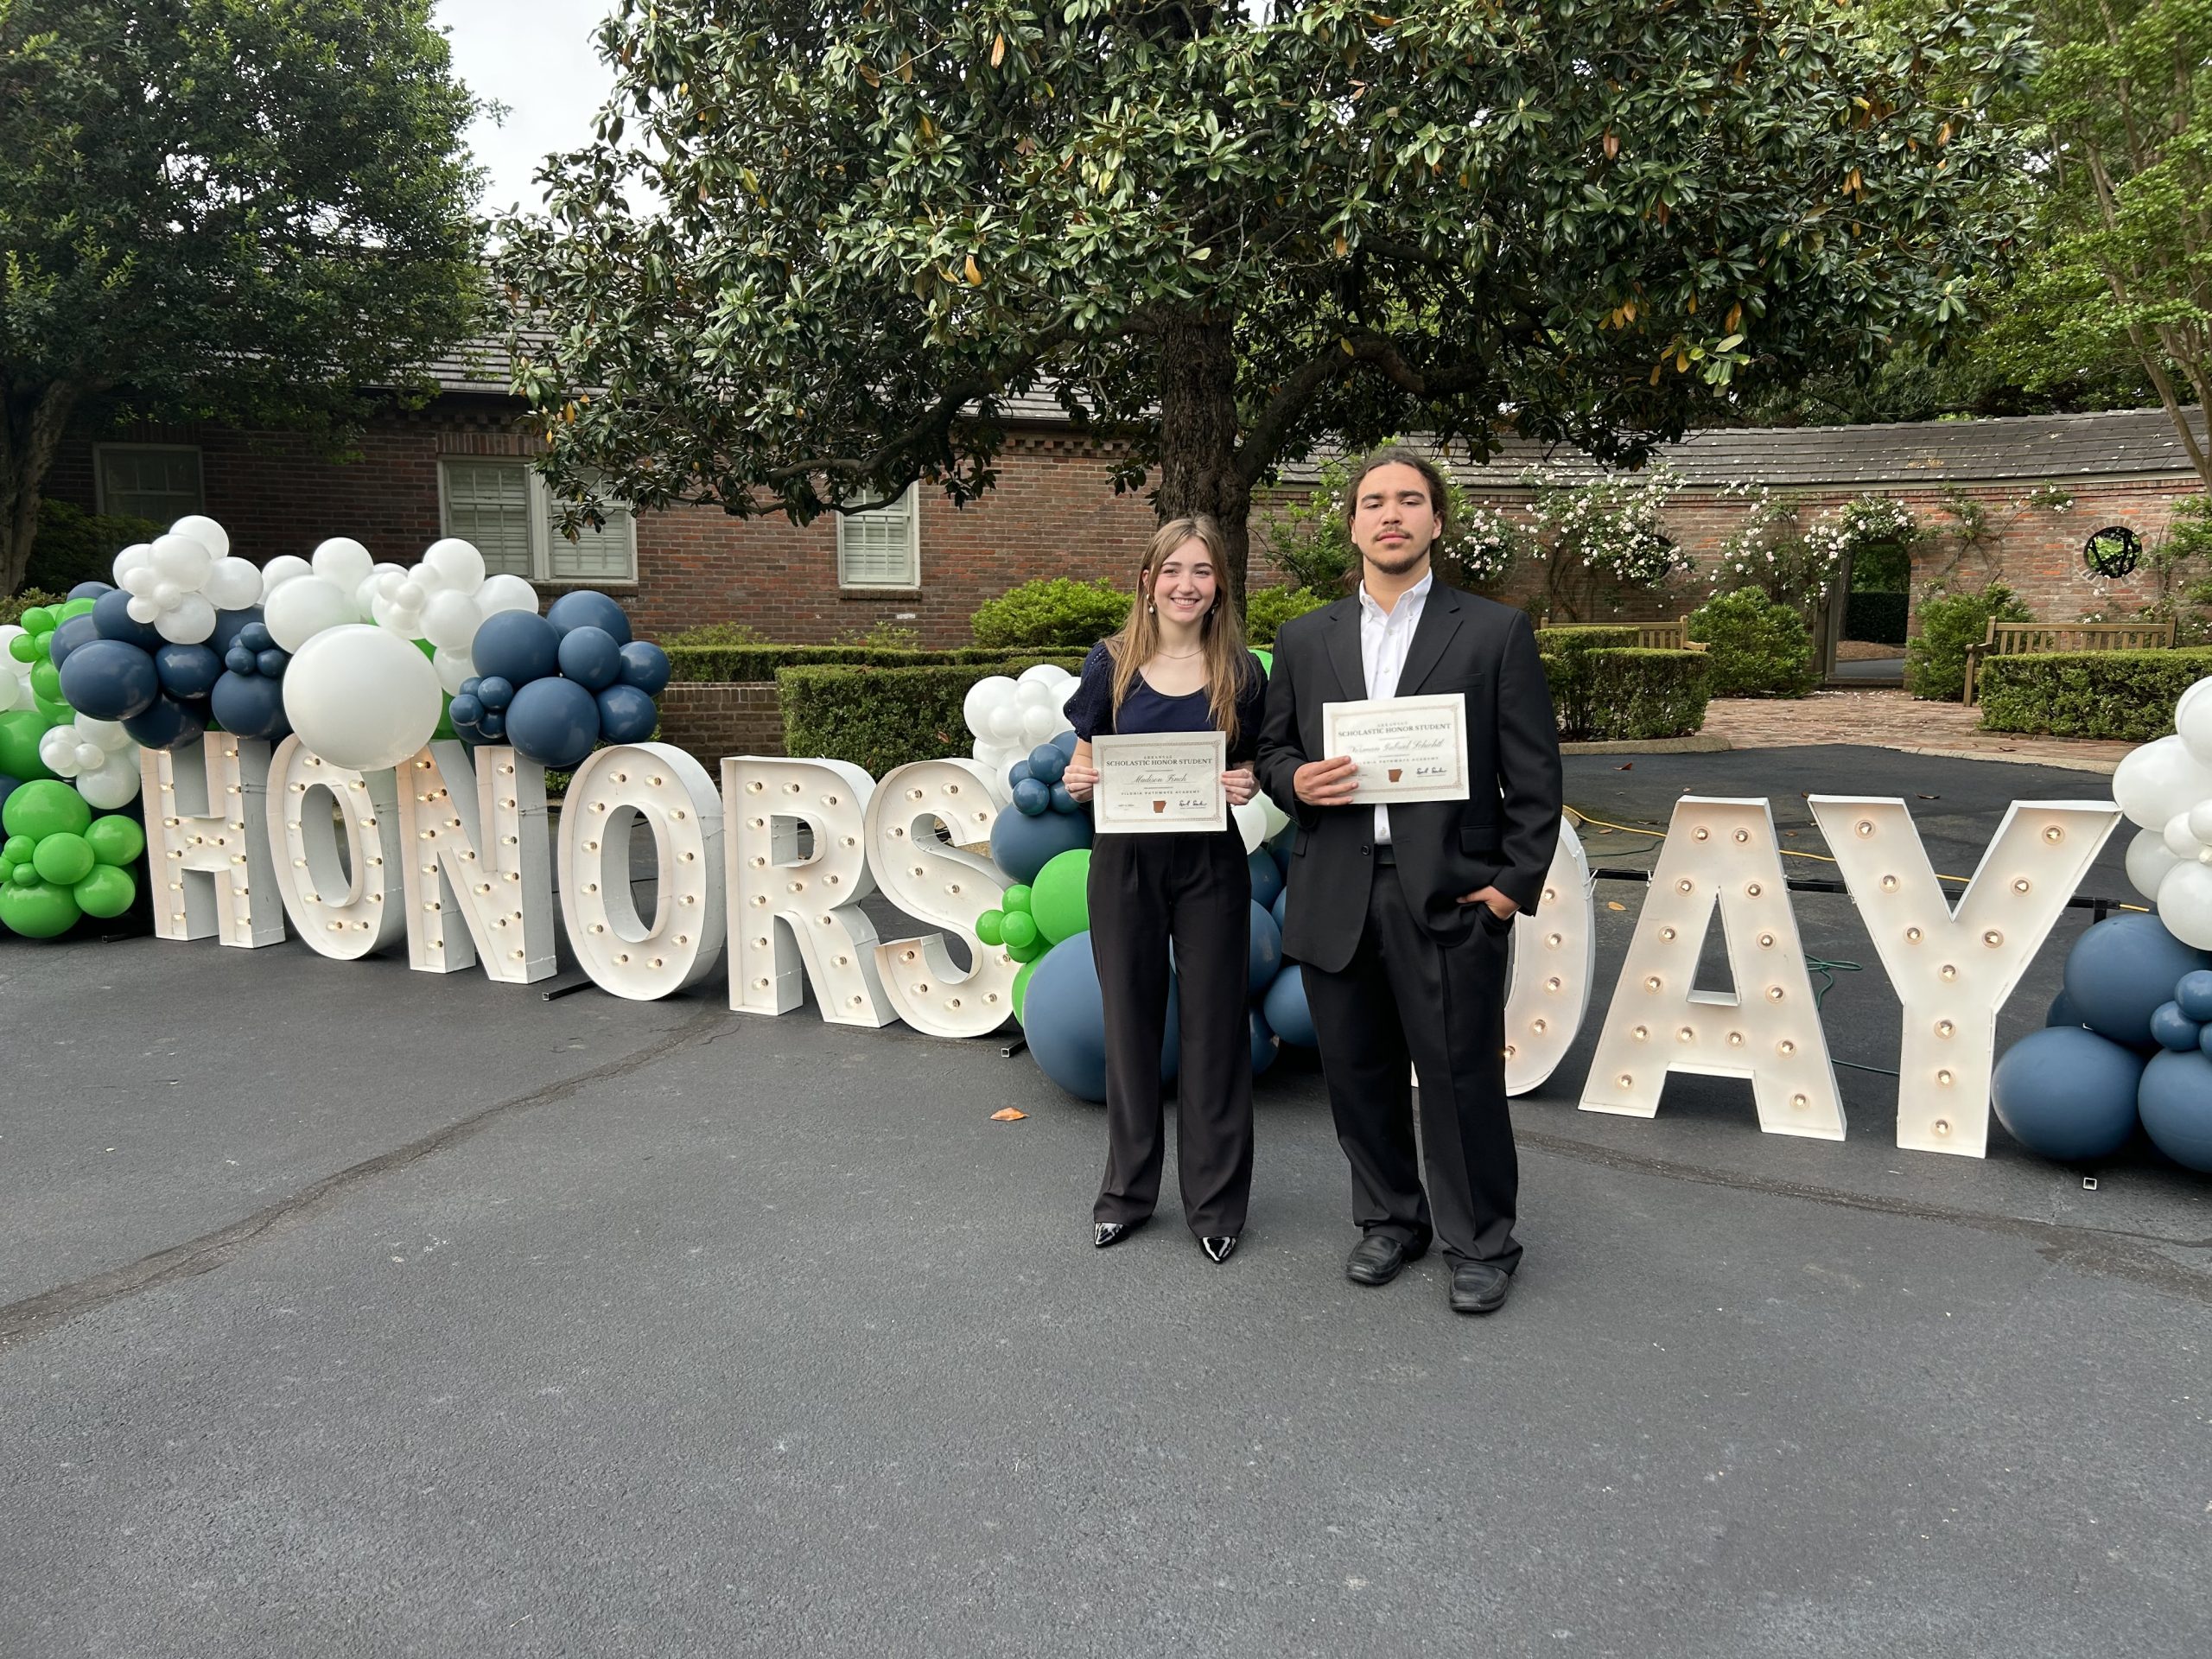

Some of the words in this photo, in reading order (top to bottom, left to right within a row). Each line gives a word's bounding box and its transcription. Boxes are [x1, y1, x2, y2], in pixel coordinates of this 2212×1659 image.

[1338, 728, 1383, 737] SCHOLASTIC
[1385, 725, 1414, 734] HONOR
[1414, 723, 1452, 732] STUDENT
[141, 731, 1025, 1038] HONORS
